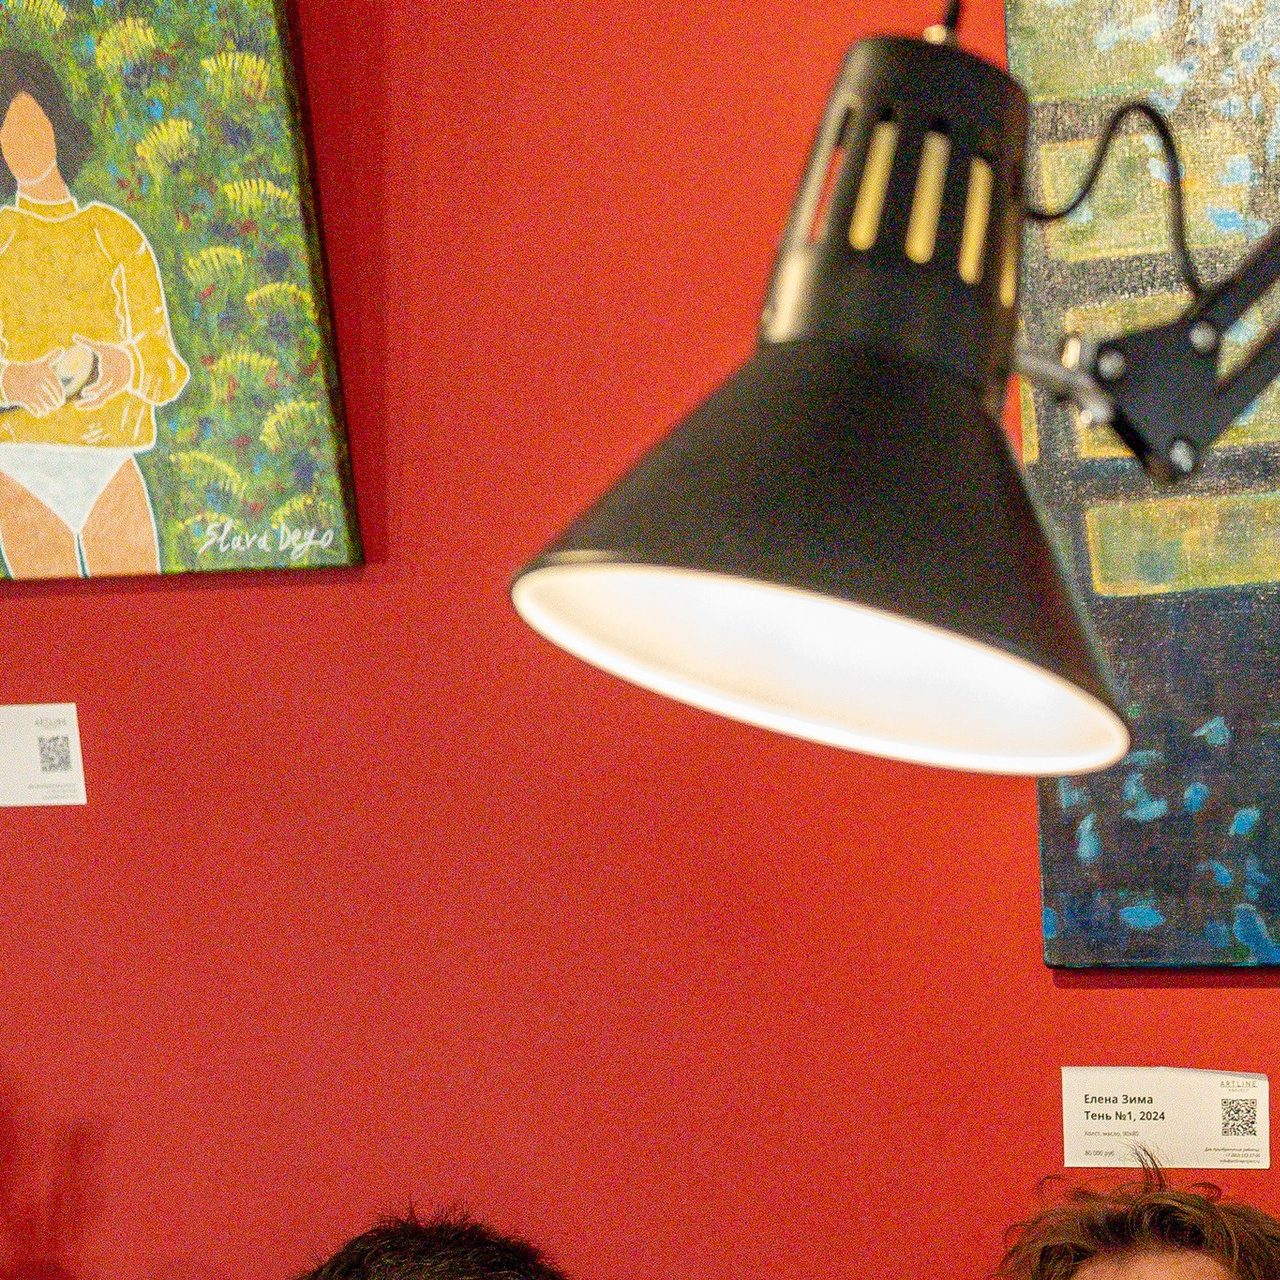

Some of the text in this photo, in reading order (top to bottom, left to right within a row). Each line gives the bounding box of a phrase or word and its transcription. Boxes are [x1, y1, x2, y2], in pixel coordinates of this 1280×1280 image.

[1084, 1094, 1154, 1104] Елена Зима
[1084, 1110, 1166, 1122] Тень №1, 2024
